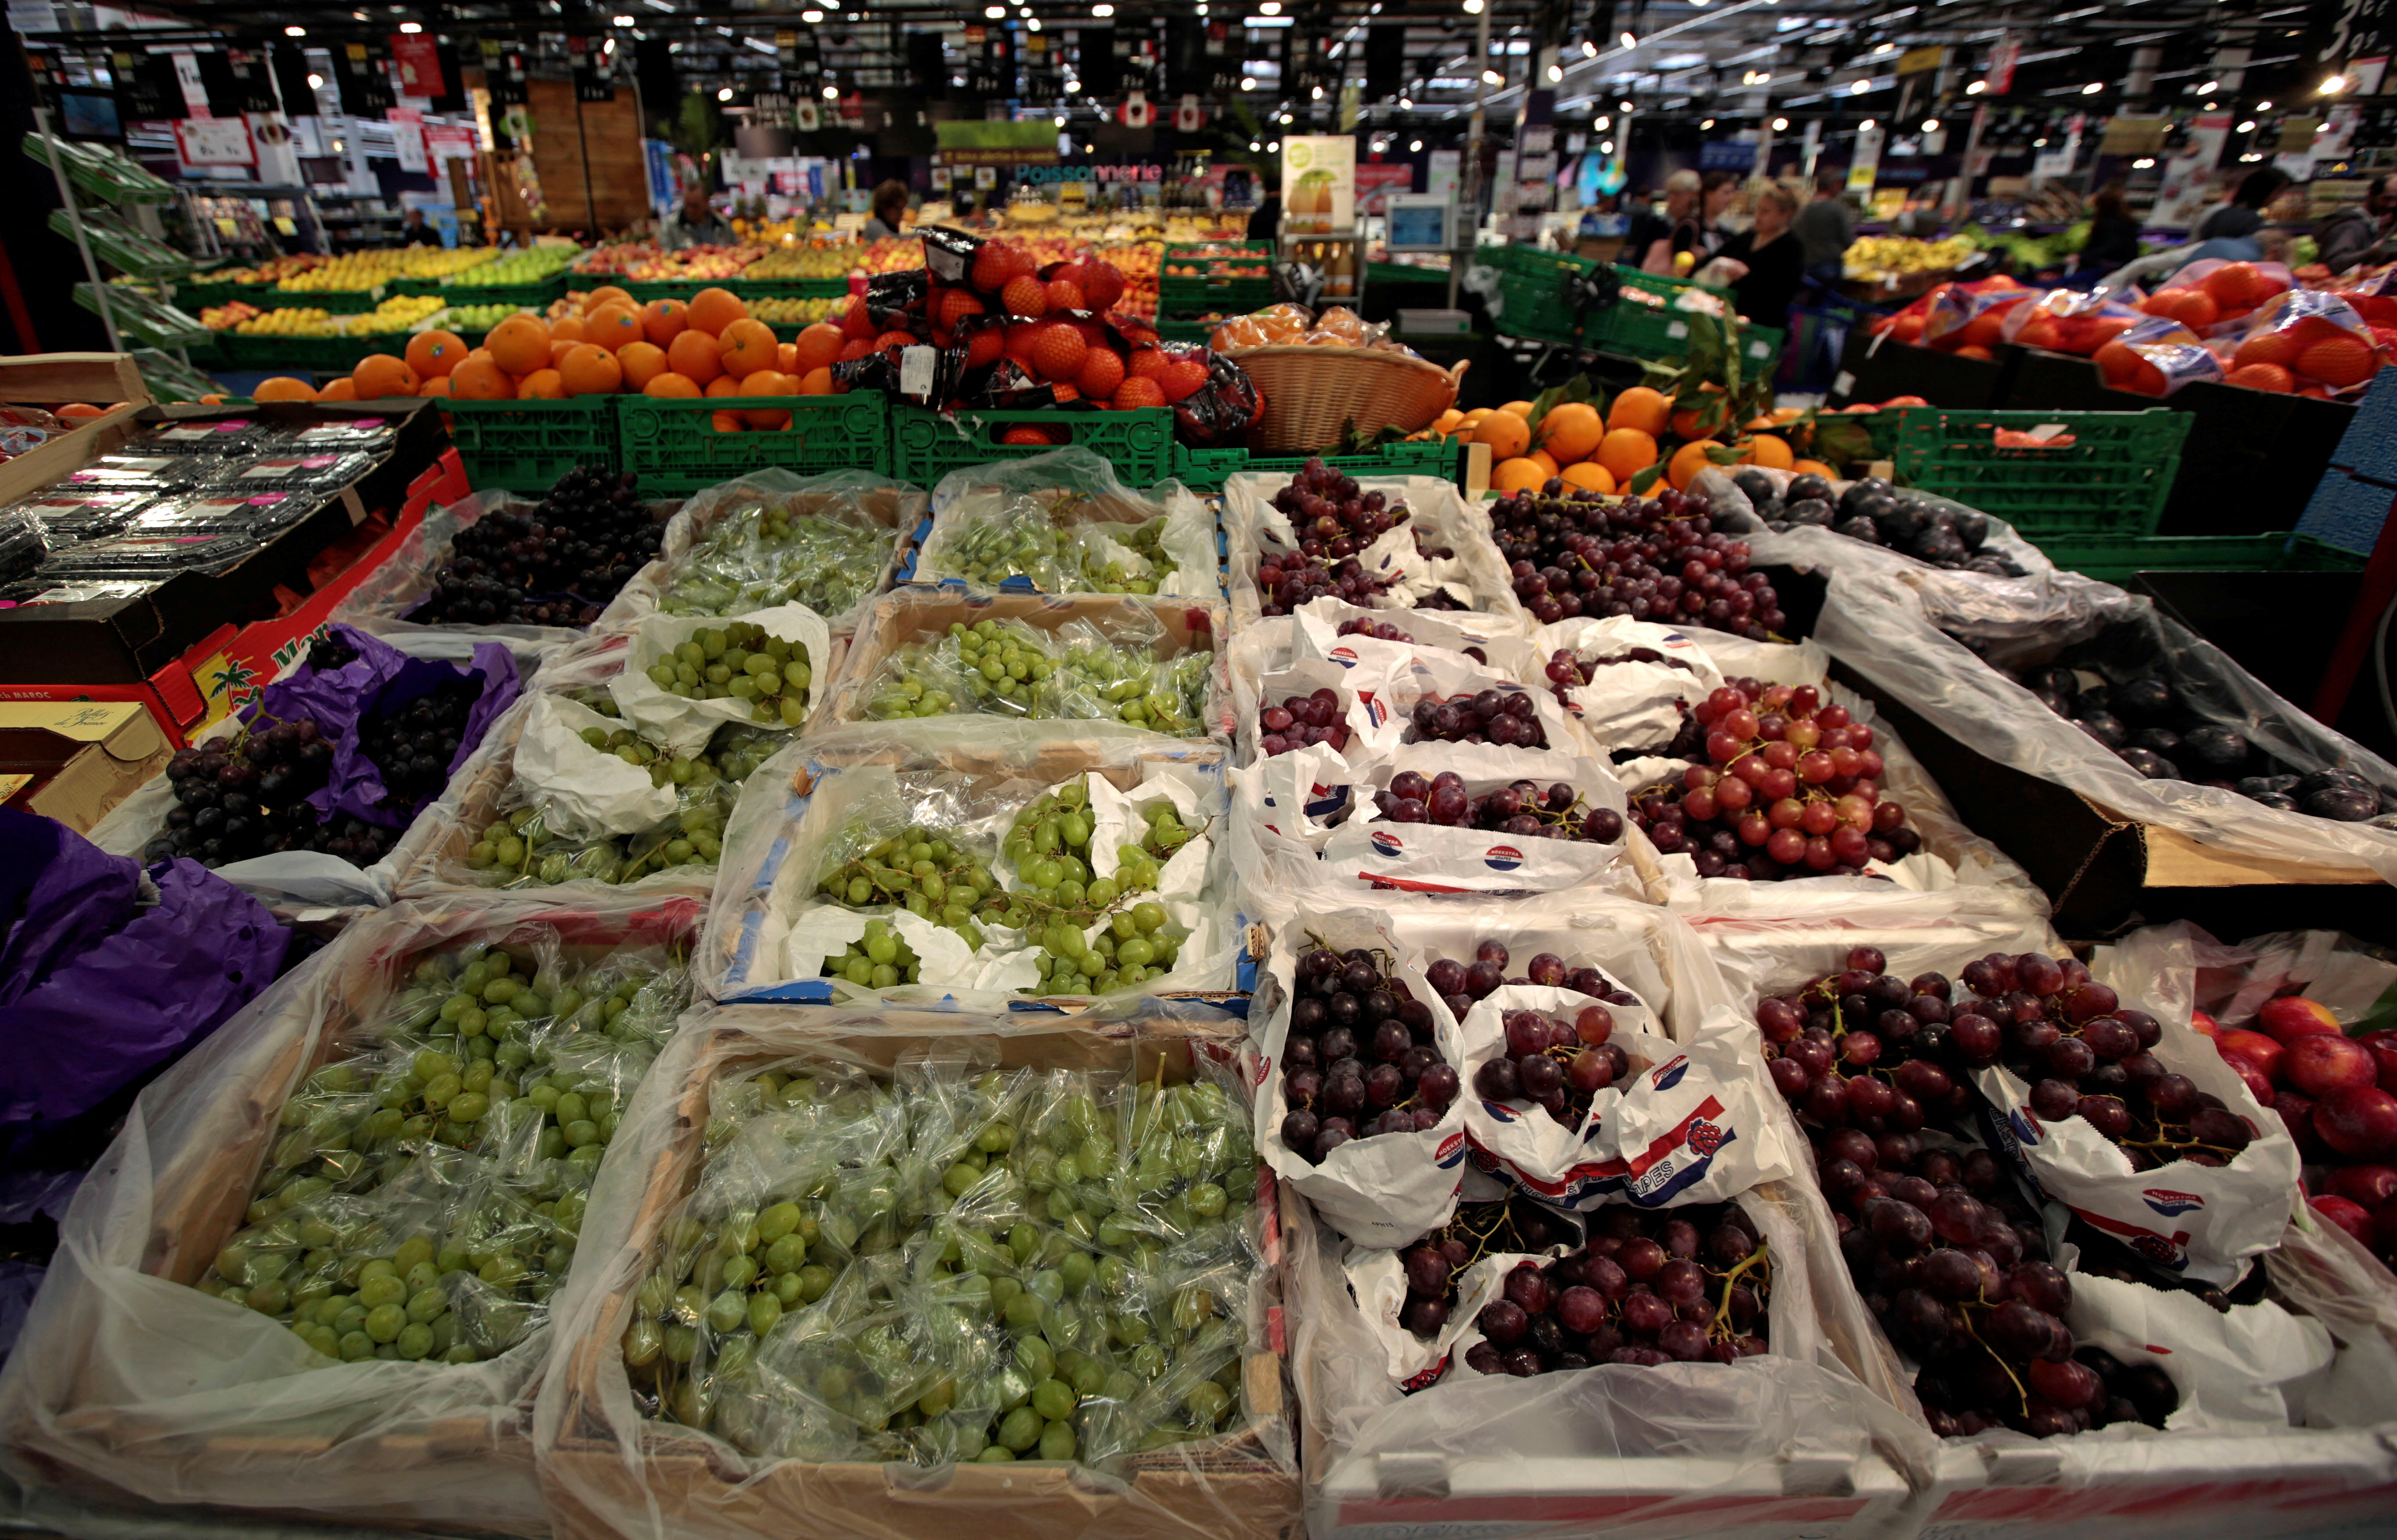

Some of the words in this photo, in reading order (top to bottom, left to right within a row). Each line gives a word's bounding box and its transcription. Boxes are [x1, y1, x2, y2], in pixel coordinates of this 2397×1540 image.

[63, 716, 107, 727] France
[2023, 1119, 2037, 1134] GRAPES
[1438, 1137, 1464, 1156] HOEKST
[2152, 1191, 2196, 1200] HOEKSTRA
